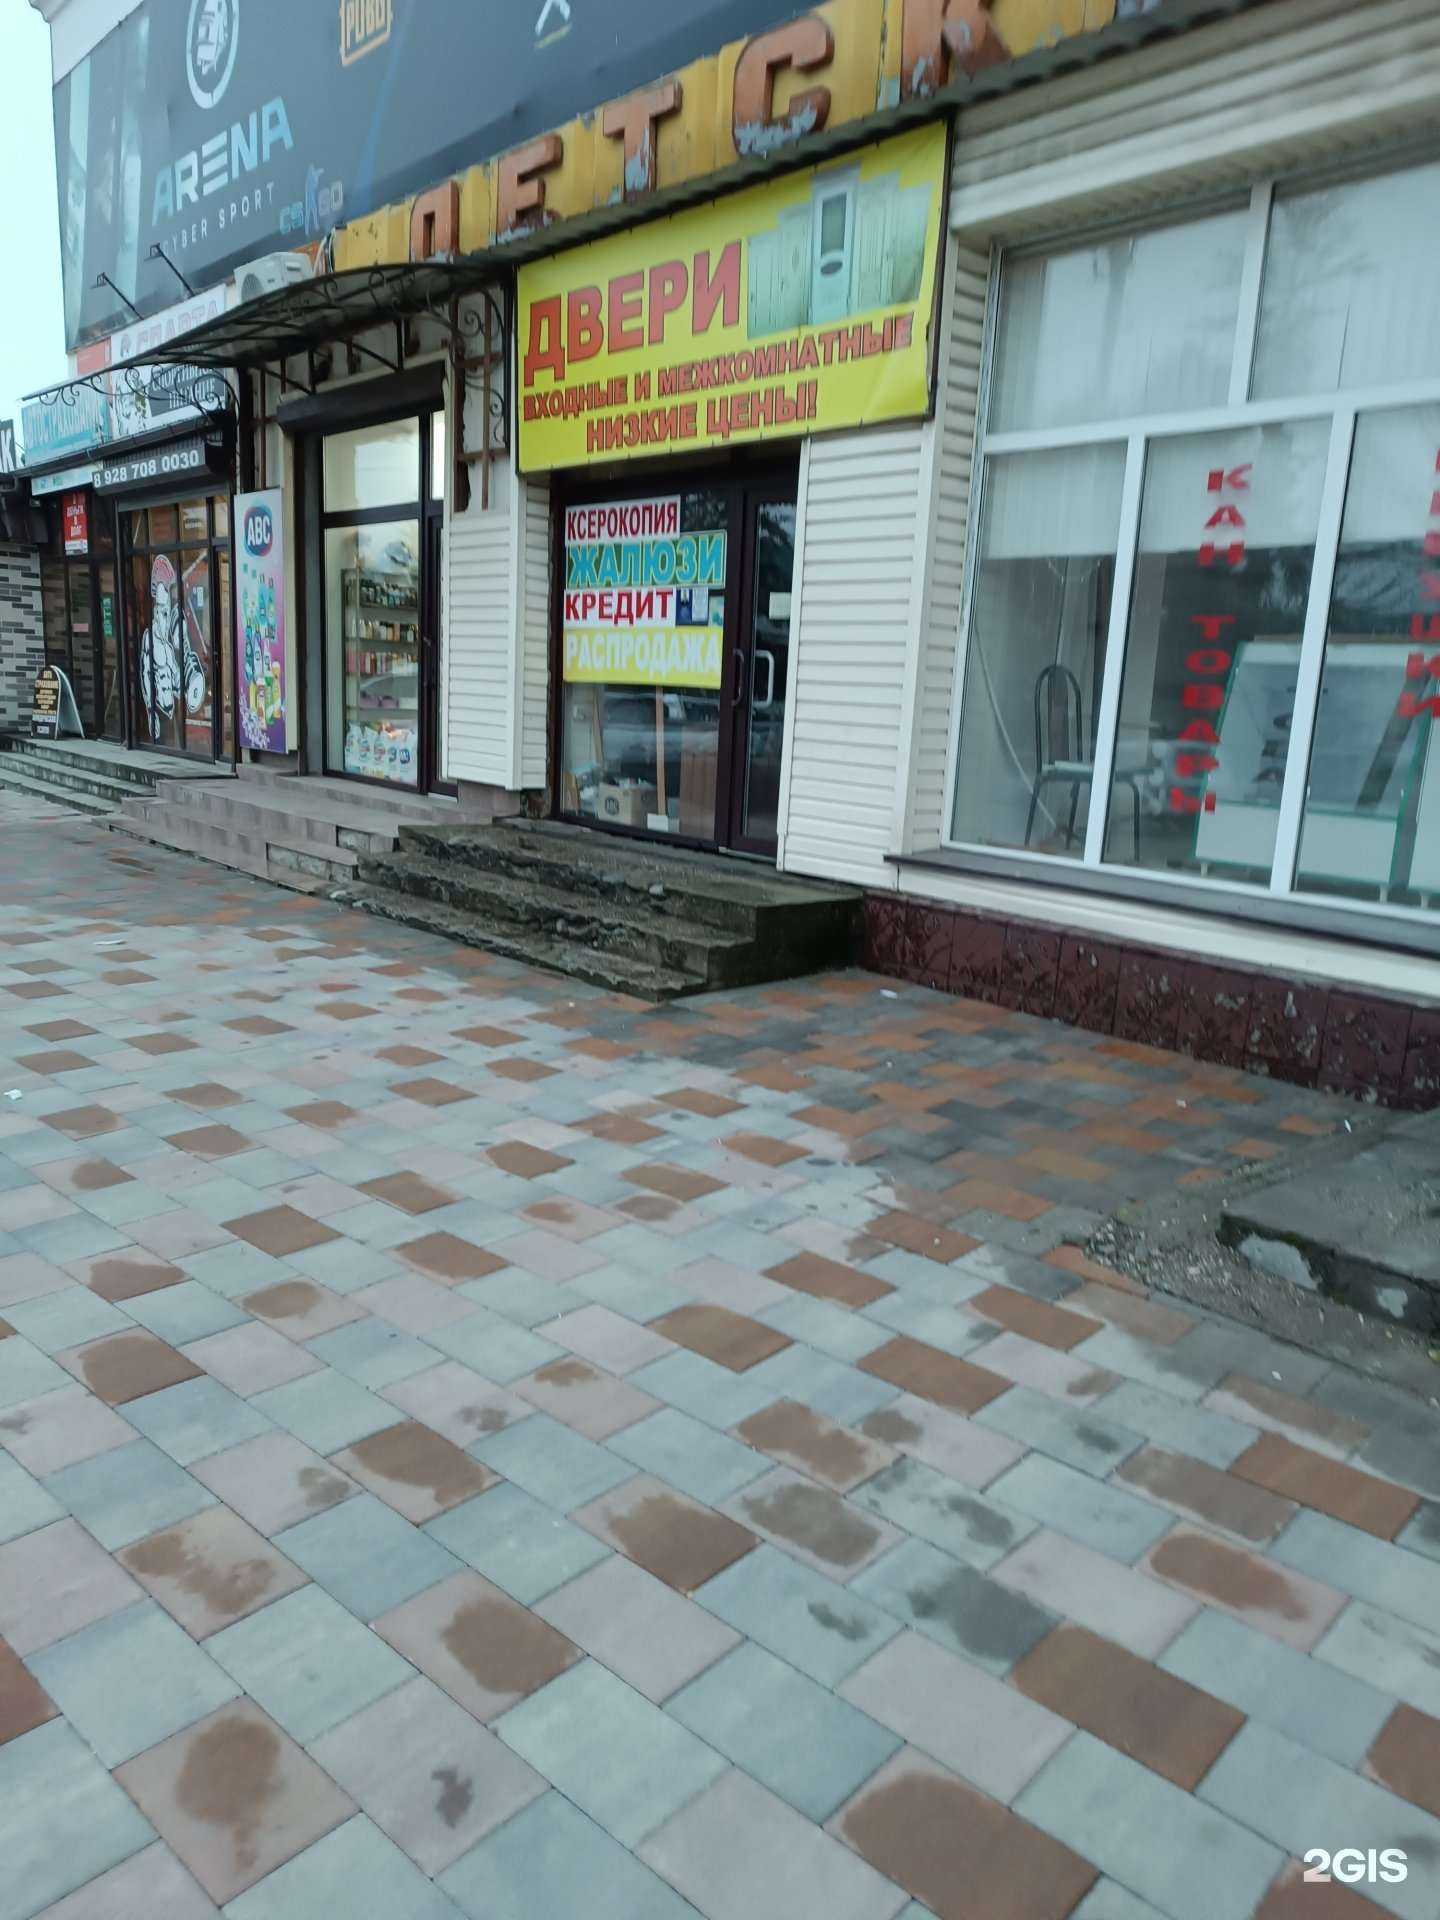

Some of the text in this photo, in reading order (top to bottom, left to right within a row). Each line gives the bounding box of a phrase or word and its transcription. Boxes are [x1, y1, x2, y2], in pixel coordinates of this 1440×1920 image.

[151, 95, 295, 227] ARENA
[218, 181, 276, 230] SPORT
[524, 239, 742, 388] ДВЕРИ
[523, 311, 915, 422] ВХОДНЫЕ И МЕЖКОМНАТНЫЕ
[586, 380, 818, 454] НИЗКИЕ ЦЕНЫ!
[93, 473, 102, 489] 8
[103, 466, 128, 485] 928
[130, 459, 157, 480] 708
[161, 450, 200, 474] 0030
[247, 515, 272, 548] ABC
[567, 502, 678, 541] КСЕРОКОПИЯ
[568, 534, 723, 586] ЖАЛЮЗИ
[565, 590, 674, 626] КРЕДИТ
[566, 632, 722, 682] РАСПРОДАЖА
[1169, 614, 1235, 815] ТОВАРЫ
